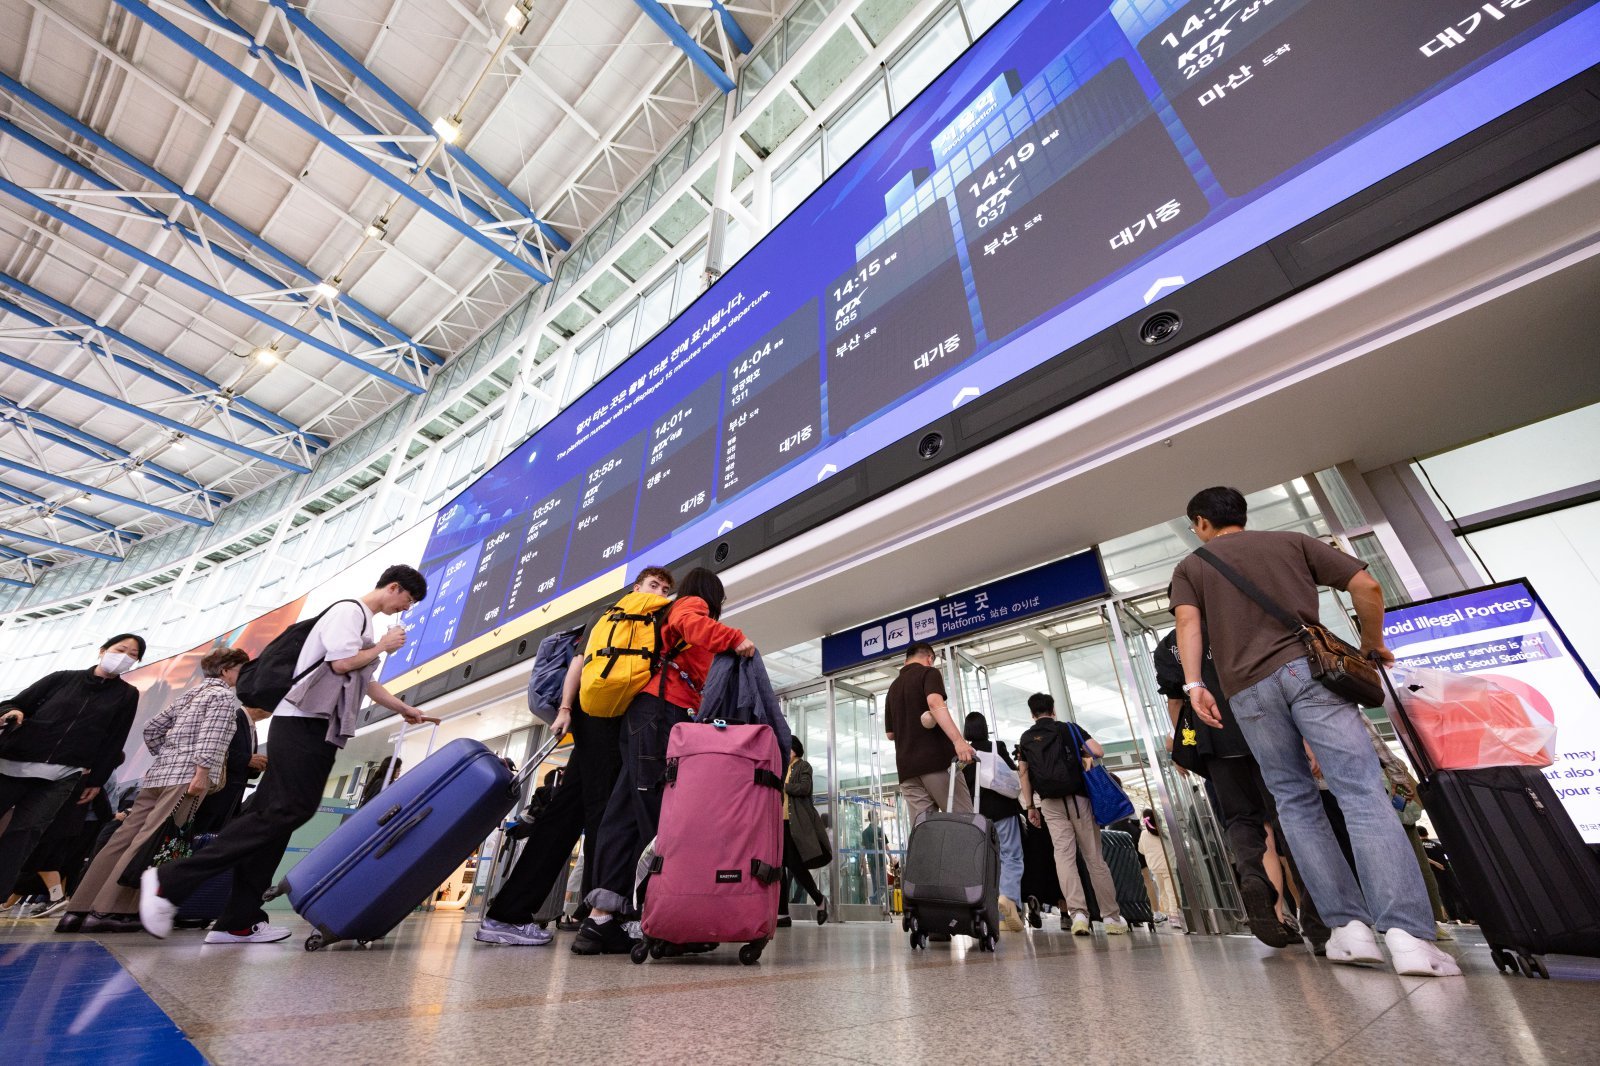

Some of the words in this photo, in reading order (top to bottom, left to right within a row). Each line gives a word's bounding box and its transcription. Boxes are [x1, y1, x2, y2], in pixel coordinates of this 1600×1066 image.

[1161, 0, 1238, 48] 14:2
[1178, 8, 1242, 69] KTX
[1183, 42, 1225, 80] 287
[1197, 64, 1254, 107] 마산
[1262, 43, 1291, 67] 도착
[969, 142, 1035, 198] 14:19
[976, 173, 1021, 218] KTX
[978, 201, 1007, 228] 037
[1109, 198, 1181, 250] 대기중
[983, 225, 1019, 256] 부산
[1024, 213, 1043, 231] 도착
[833, 258, 881, 302] 14:15
[834, 286, 869, 322] KTX
[835, 310, 857, 331] 085
[592, 404, 609, 421] 타는
[610, 389, 627, 410] 곳은
[648, 356, 669, 380] 15분
[670, 337, 690, 362] 전에
[690, 292, 746, 345] 표시됩니다.
[835, 333, 861, 357] 부산
[913, 333, 961, 370] 대기중
[556, 450, 567, 461] The
[566, 433, 590, 456] platform
[590, 416, 613, 437] number
[613, 407, 624, 420] will
[623, 402, 633, 413] be
[633, 376, 665, 405] displayed
[665, 370, 673, 381] 15
[673, 346, 701, 374] minutes
[702, 325, 727, 350] before
[727, 289, 771, 328] departure.
[733, 342, 772, 380] 14:04
[731, 368, 761, 396] 무궁화호
[731, 388, 749, 407] 1311
[655, 409, 683, 440] 14:01
[728, 411, 748, 432] 부산
[779, 424, 813, 453] 대기중
[588, 458, 615, 485] 13:58
[650, 450, 663, 465] 815
[533, 499, 555, 521] 13:53
[680, 490, 706, 513] 대기중
[602, 540, 625, 559] 대기중
[940, 601, 968, 619] 타는
[974, 591, 990, 612] 곳
[1383, 619, 1415, 637] void
[1464, 596, 1532, 619] Porters
[914, 616, 935, 630] 무궁화
[942, 613, 986, 633] Platforms
[989, 606, 1009, 619] 站台
[863, 634, 881, 648] KTX
[1432, 650, 1467, 666] porter
[1469, 643, 1507, 657] service
[1507, 639, 1520, 650] is
[1522, 635, 1544, 648] not
[1452, 661, 1466, 671] at
[1465, 656, 1499, 670] Seoul
[1563, 750, 1596, 762] may
[1544, 769, 1562, 780] ut
[1564, 767, 1595, 779] also
[1555, 786, 1590, 800] your
